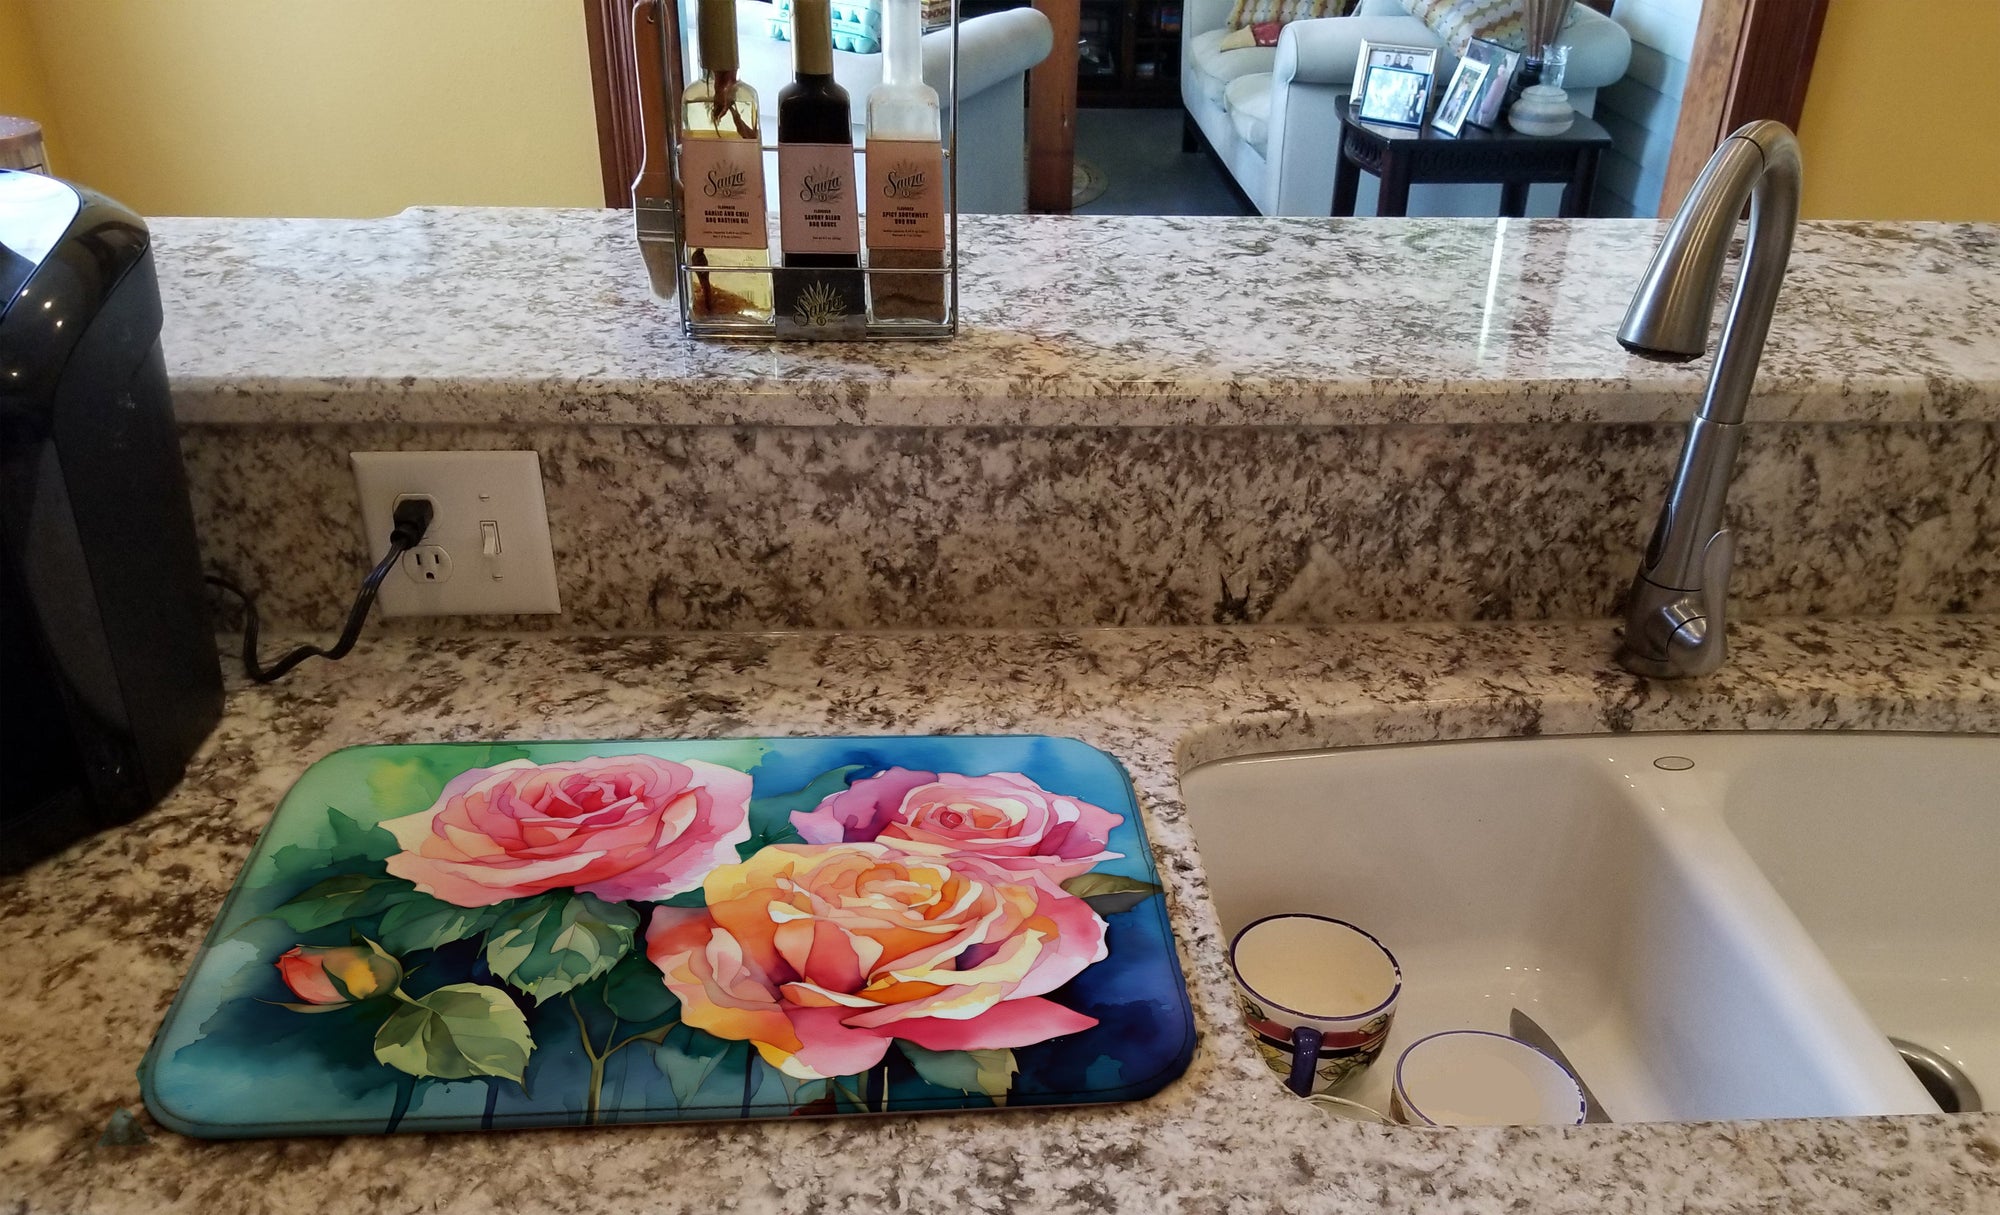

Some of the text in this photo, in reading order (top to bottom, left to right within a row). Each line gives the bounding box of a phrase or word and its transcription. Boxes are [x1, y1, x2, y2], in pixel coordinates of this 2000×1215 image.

[703, 170, 746, 198] Sauza
[800, 175, 842, 202] Sauza
[883, 170, 926, 198] Sauza
